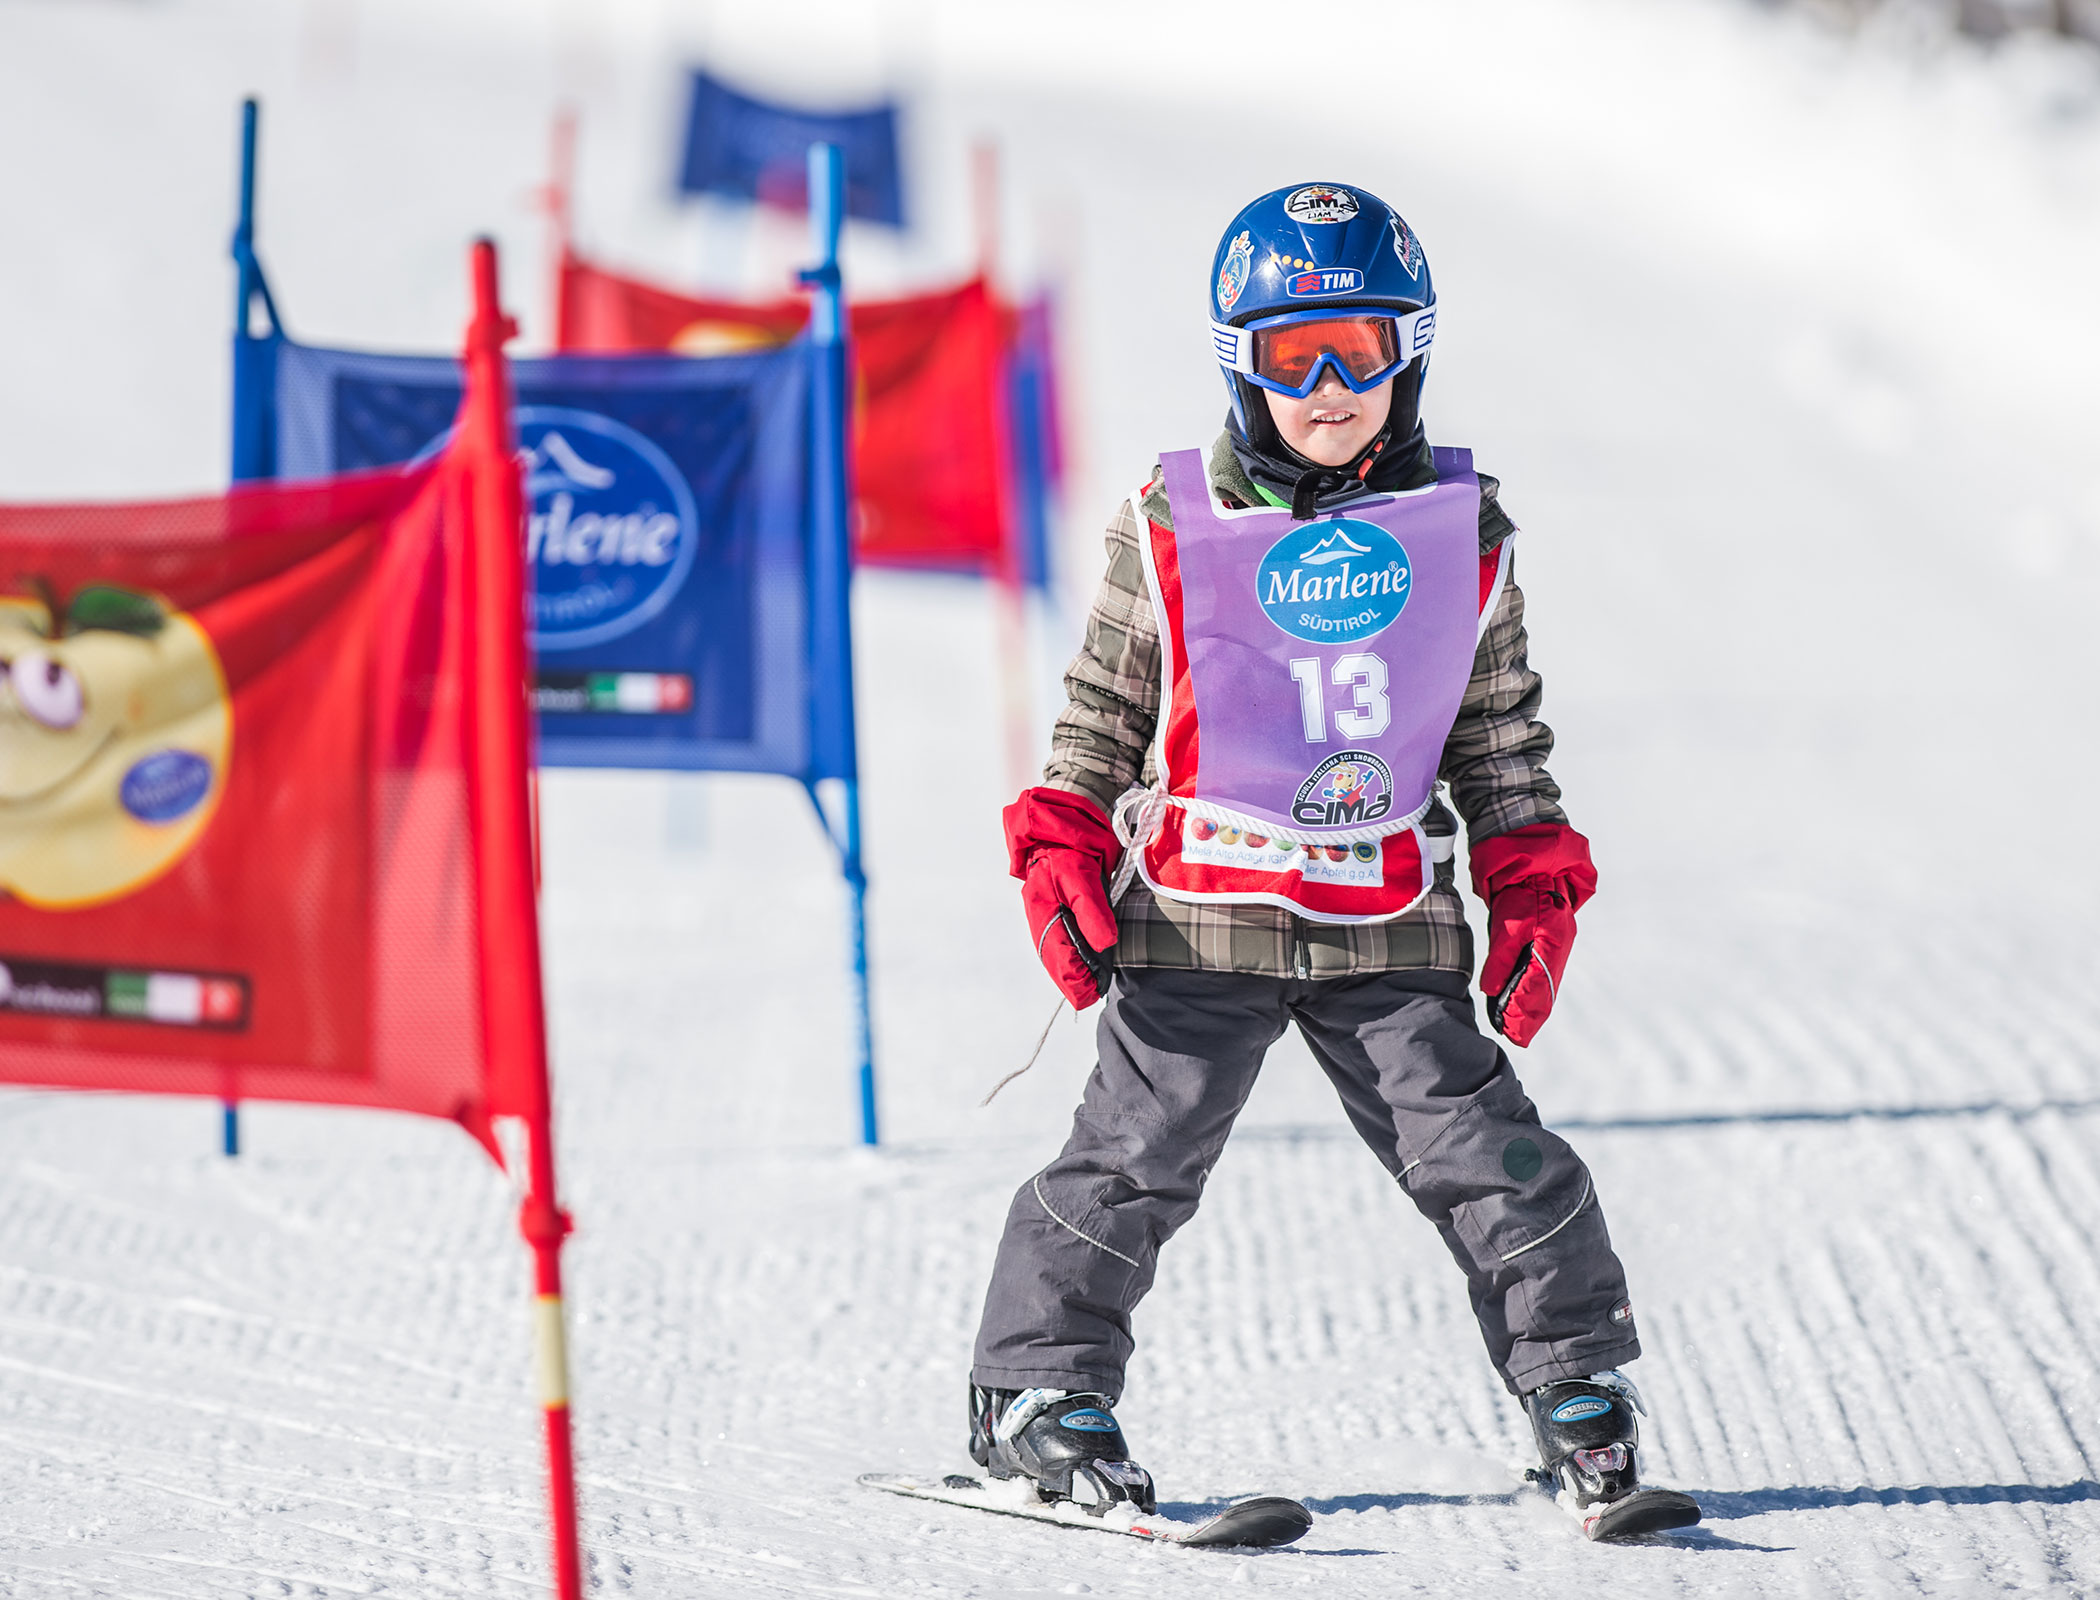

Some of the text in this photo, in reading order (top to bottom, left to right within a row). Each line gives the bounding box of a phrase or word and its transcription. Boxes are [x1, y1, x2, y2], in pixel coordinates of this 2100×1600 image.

[1308, 211, 1332, 219] LIAM
[1322, 272, 1355, 290] TIM
[1298, 608, 1381, 632] SÜDTIROL
[1289, 652, 1391, 743] 13
[1298, 781, 1315, 802] SCUOLA
[1313, 757, 1339, 784] ITALIANA
[1340, 753, 1352, 761] SCI
[1188, 845, 1212, 857] Mela
[1214, 848, 1235, 860] Alto
[1236, 851, 1264, 865] Adige
[1268, 854, 1288, 864] IGP
[1321, 866, 1346, 878] Apfel
